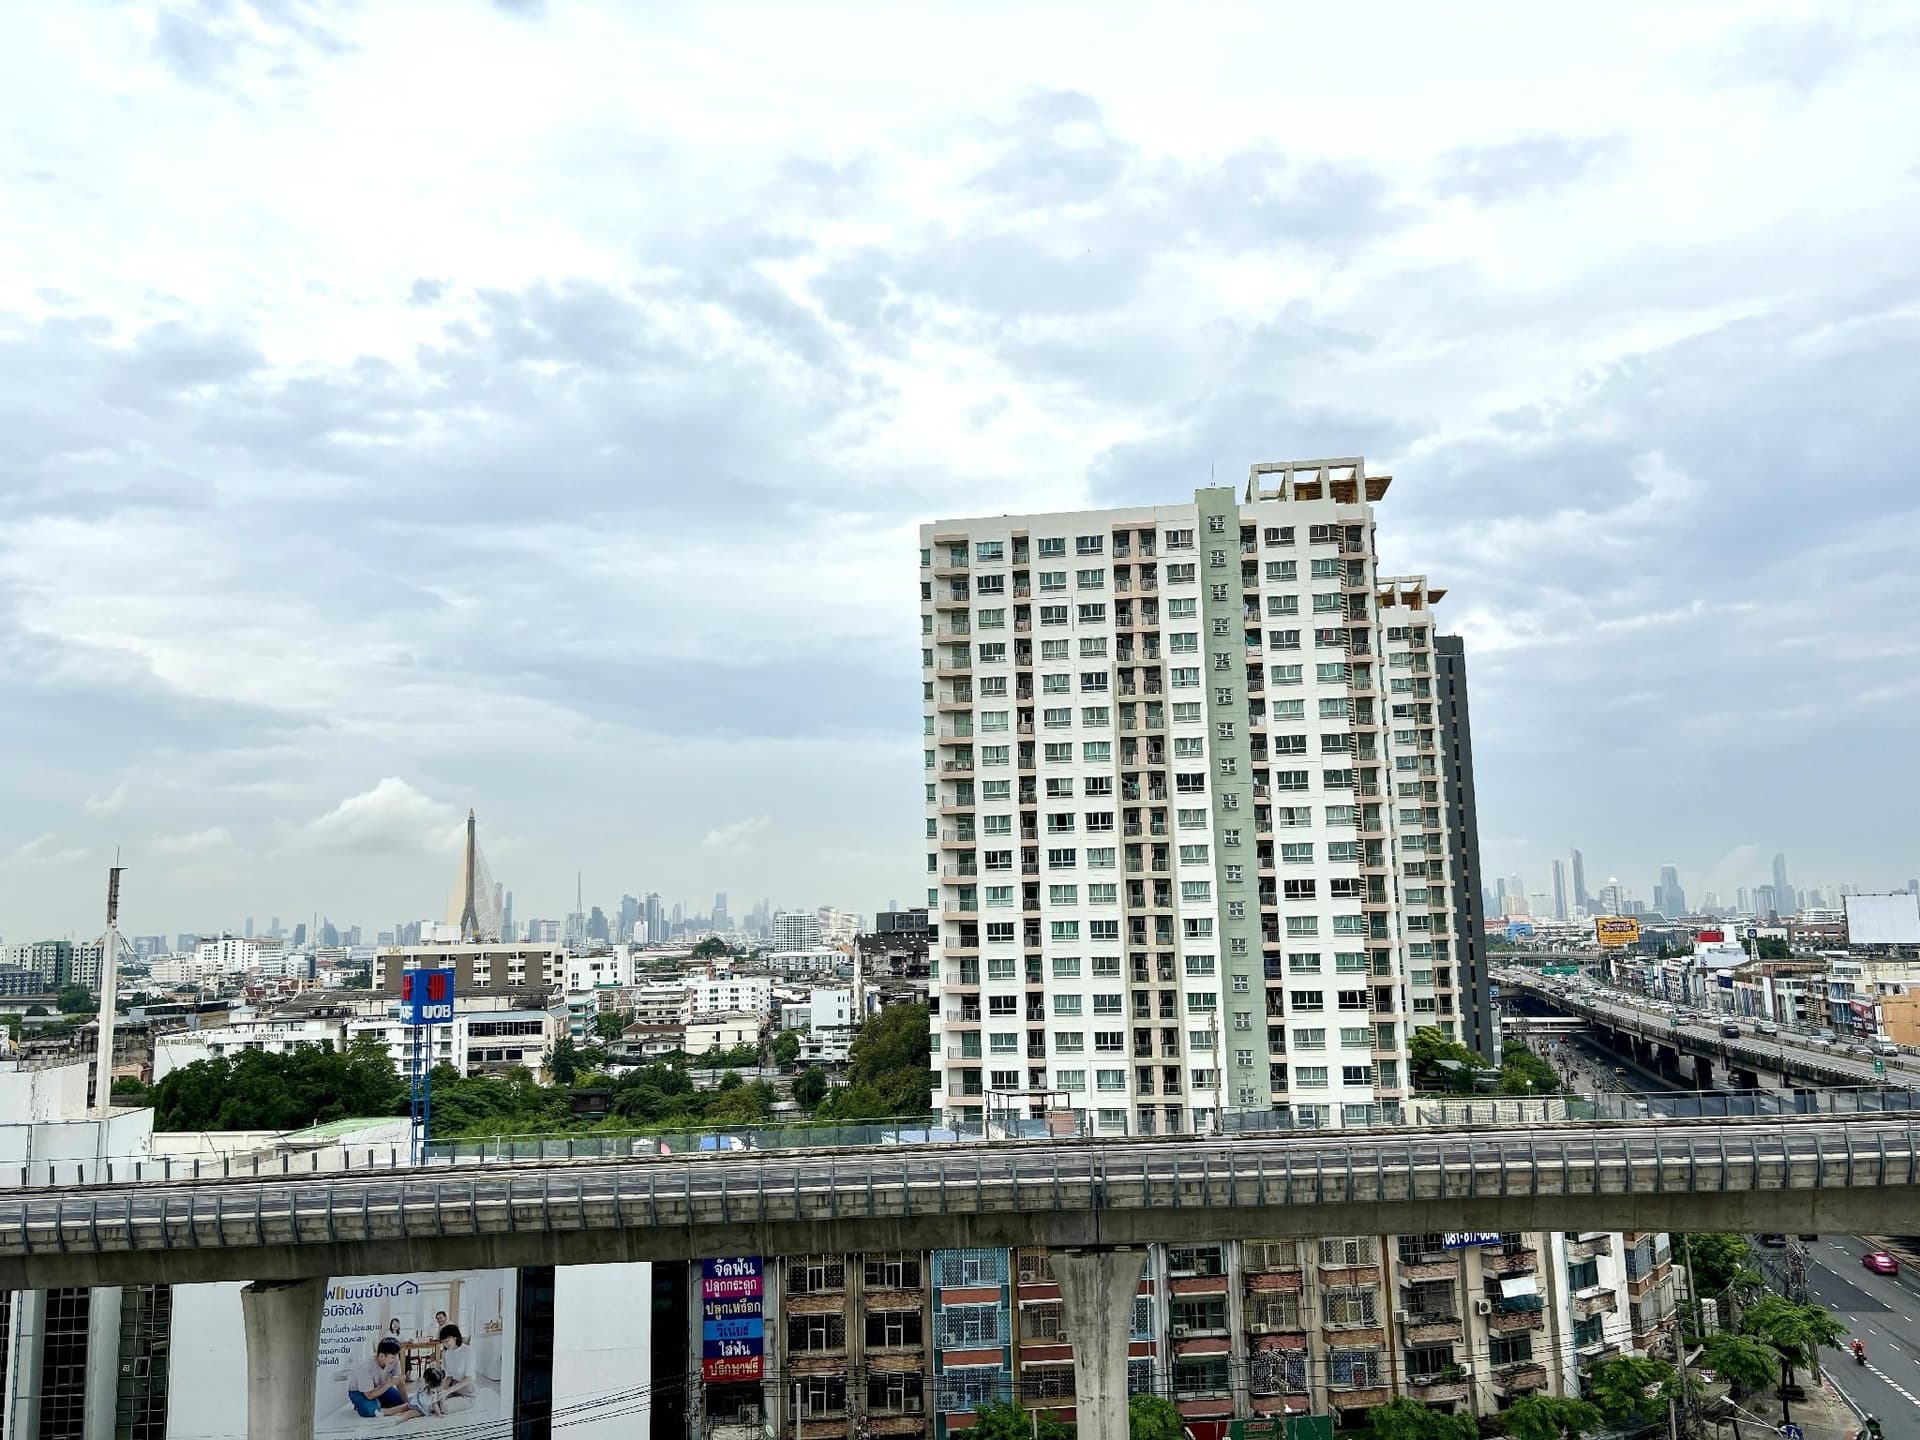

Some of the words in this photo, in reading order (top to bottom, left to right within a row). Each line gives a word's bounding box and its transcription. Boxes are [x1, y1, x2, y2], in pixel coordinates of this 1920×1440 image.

[422, 1004, 451, 1018] UOB
[713, 1257, 756, 1277] จัดฟัน
[705, 1279, 757, 1297] ปลูกกระดูก
[719, 1340, 751, 1357] ใส่ฟัน
